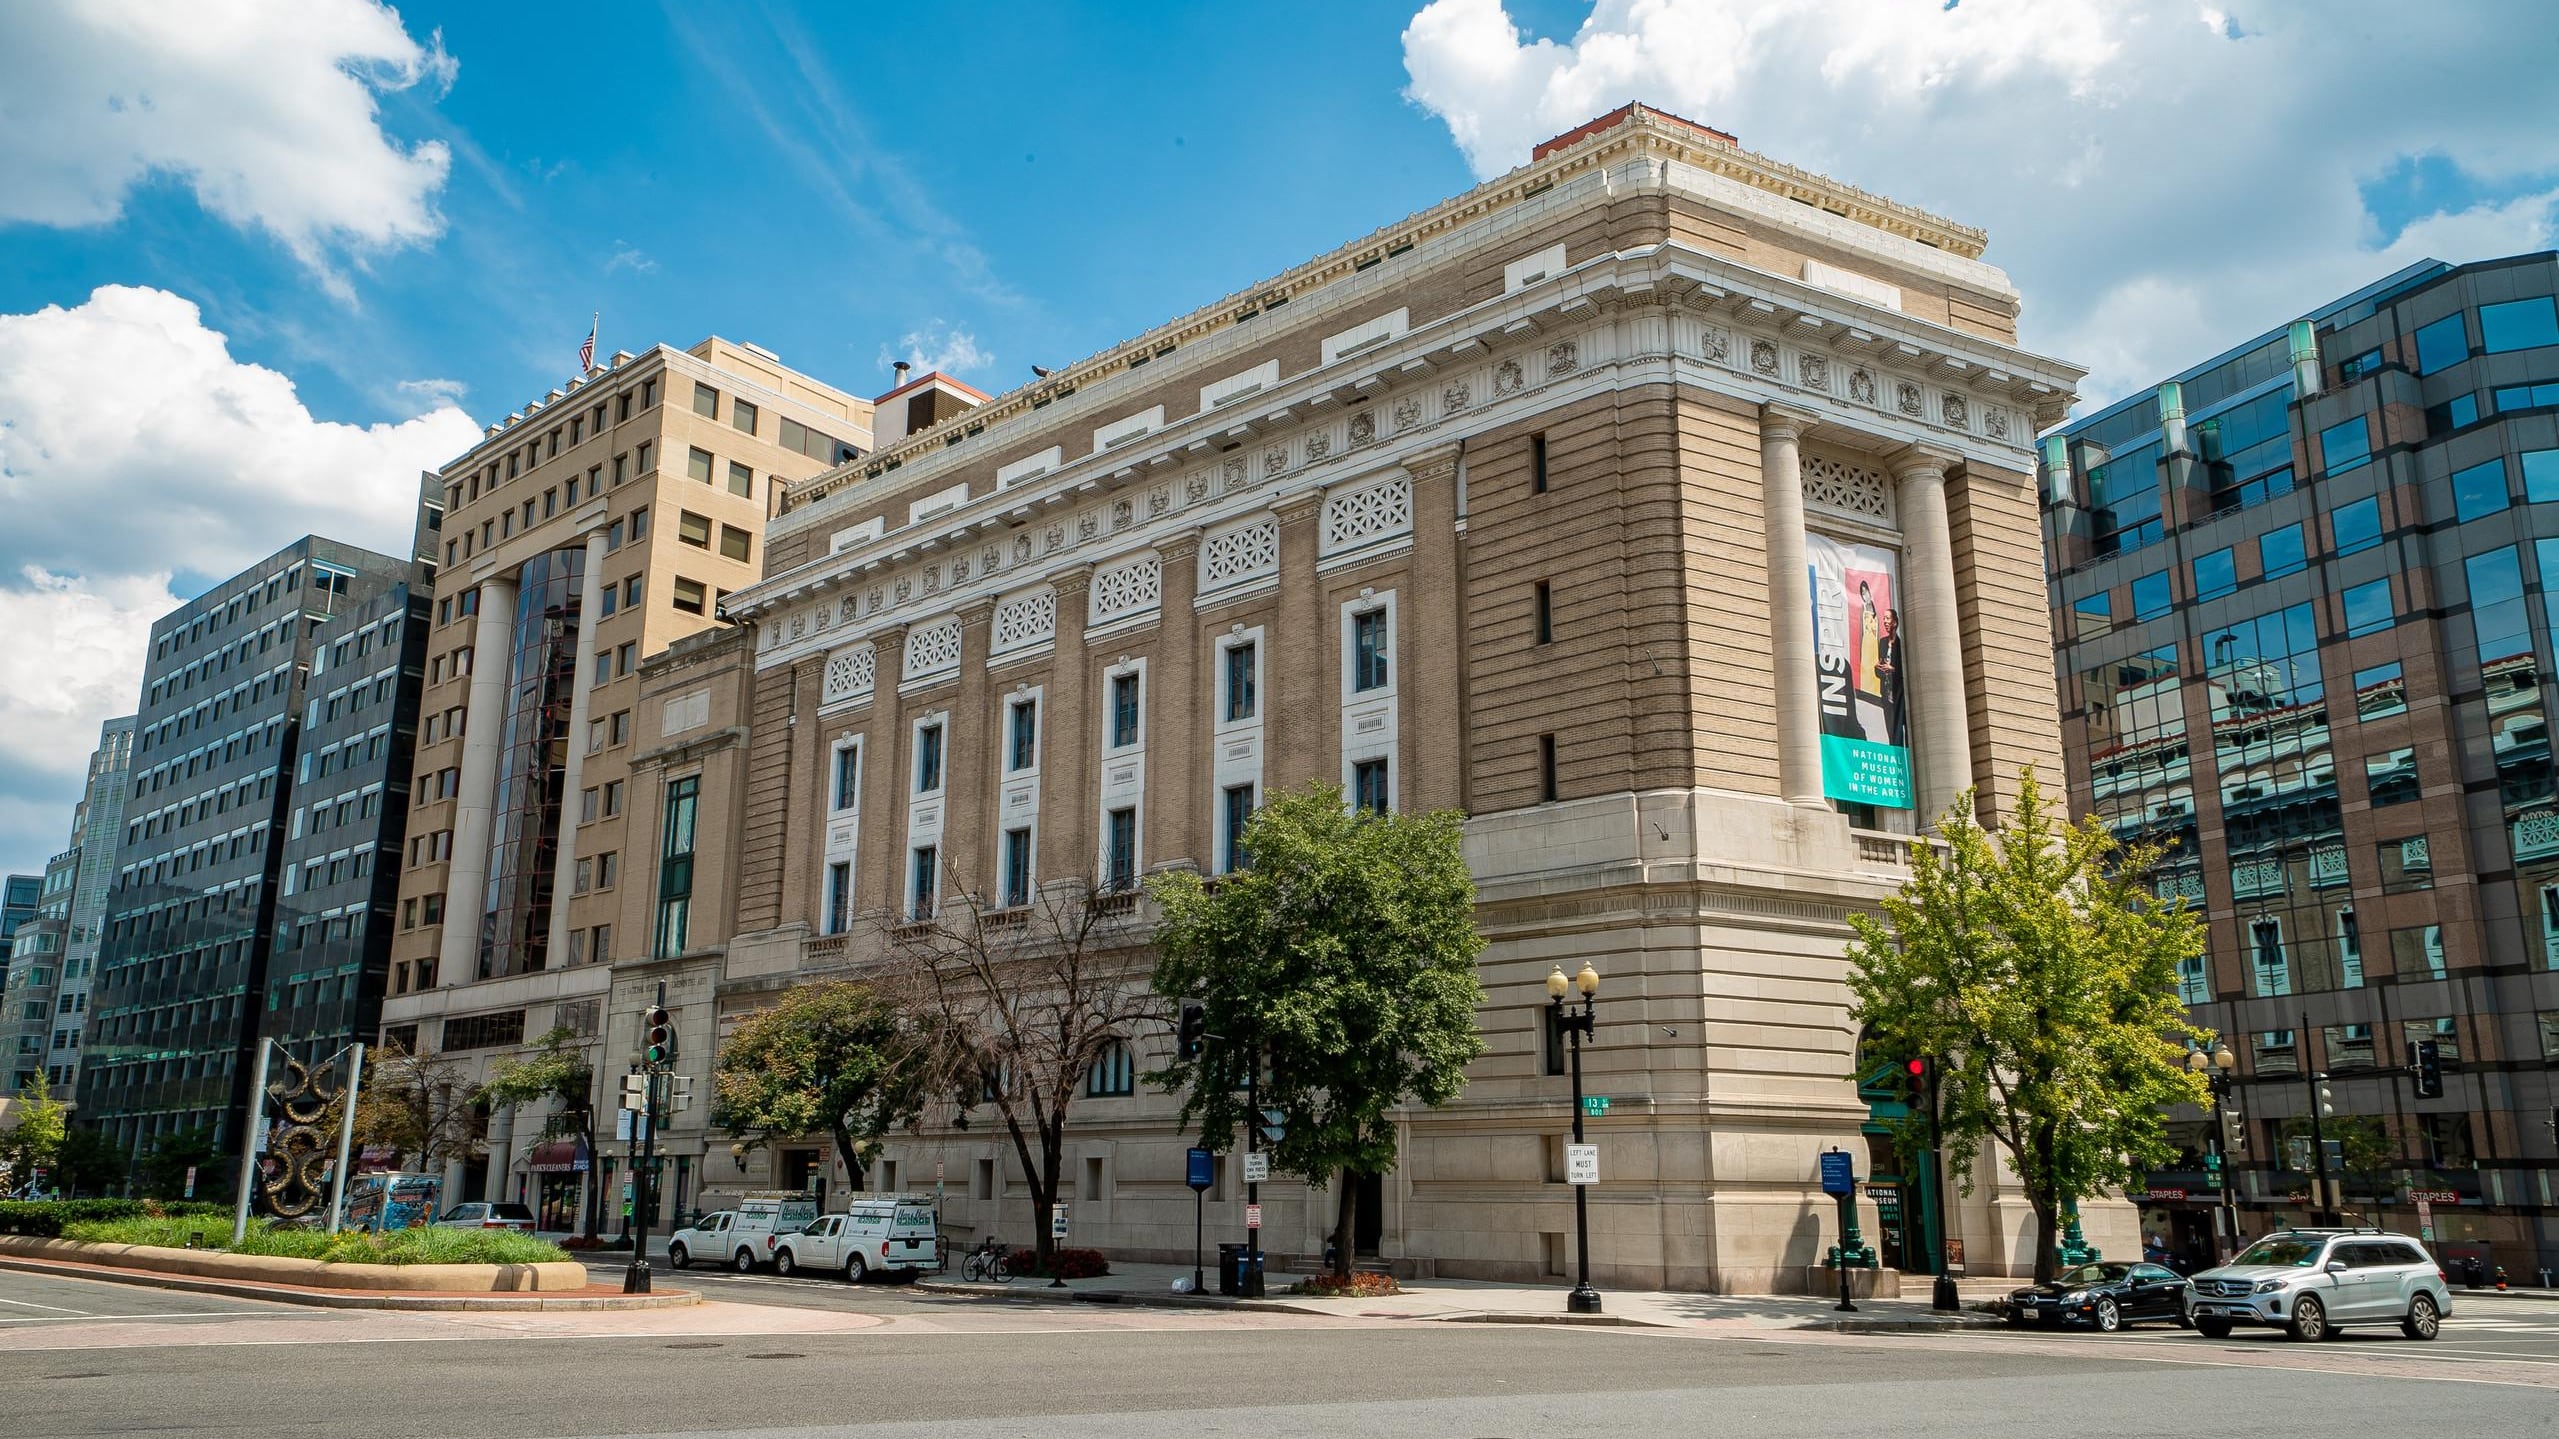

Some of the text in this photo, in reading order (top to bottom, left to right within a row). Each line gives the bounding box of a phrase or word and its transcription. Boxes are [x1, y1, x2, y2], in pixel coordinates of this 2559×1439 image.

[1852, 749, 1903, 765] NATIONAL
[1861, 762, 1904, 776] MUSEUM
[1853, 772, 1905, 788] OF WOMEN
[1848, 782, 1906, 799] IN THE ARTS
[1588, 1098, 1598, 1108] 13
[1569, 1149, 1596, 1157] LEFT LANE
[546, 1163, 571, 1172] CLEANERS
[1575, 1160, 1592, 1168] MUST
[1571, 1171, 1597, 1179] TURN LEFT
[1867, 1189, 1897, 1197] ATIONAL
[2149, 1190, 2184, 1200] STAPLES
[2410, 1192, 2456, 1202] STAPLES
[1874, 1197, 1898, 1205] USEUM
